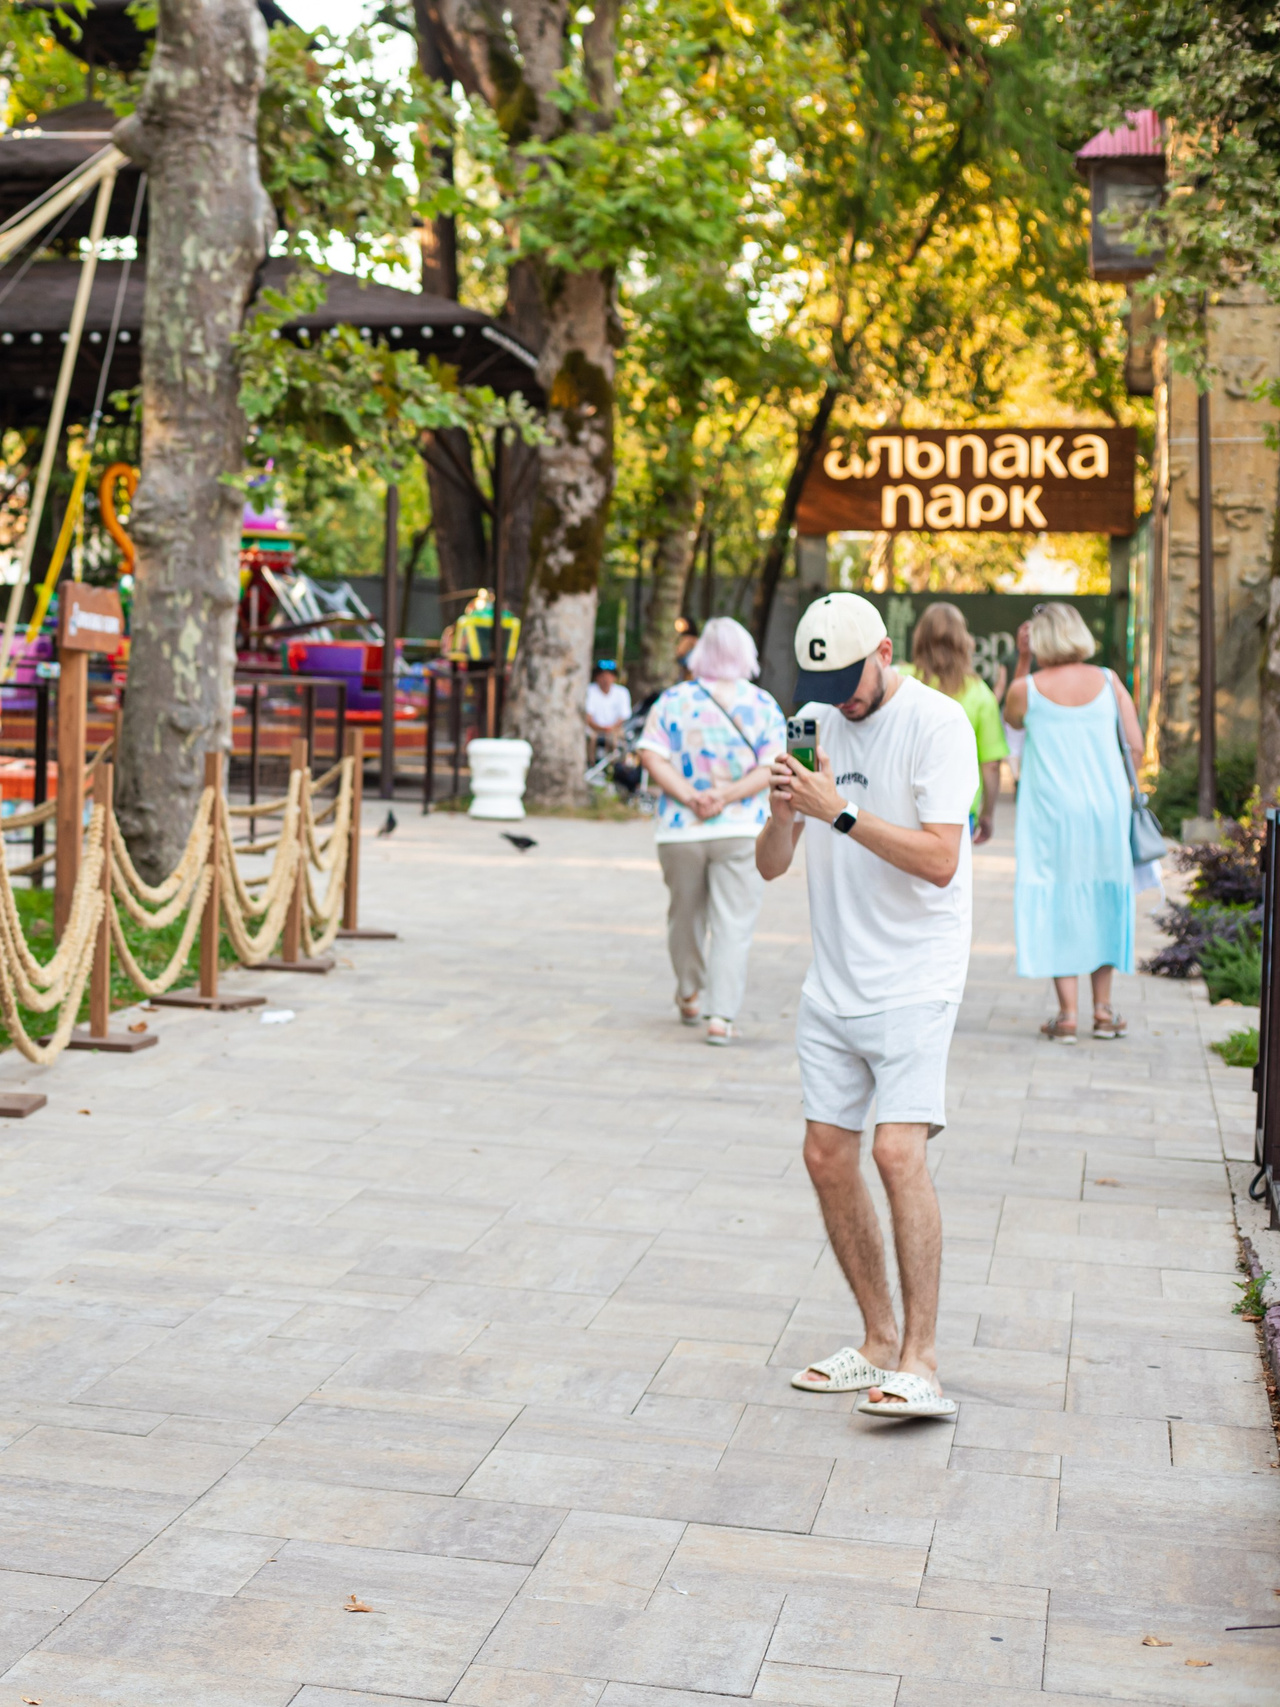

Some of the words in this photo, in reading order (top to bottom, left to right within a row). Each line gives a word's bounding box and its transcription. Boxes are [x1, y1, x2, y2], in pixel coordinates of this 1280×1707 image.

[823, 434, 1110, 480] альпака
[881, 483, 1048, 529] парк
[809, 638, 826, 661] C
